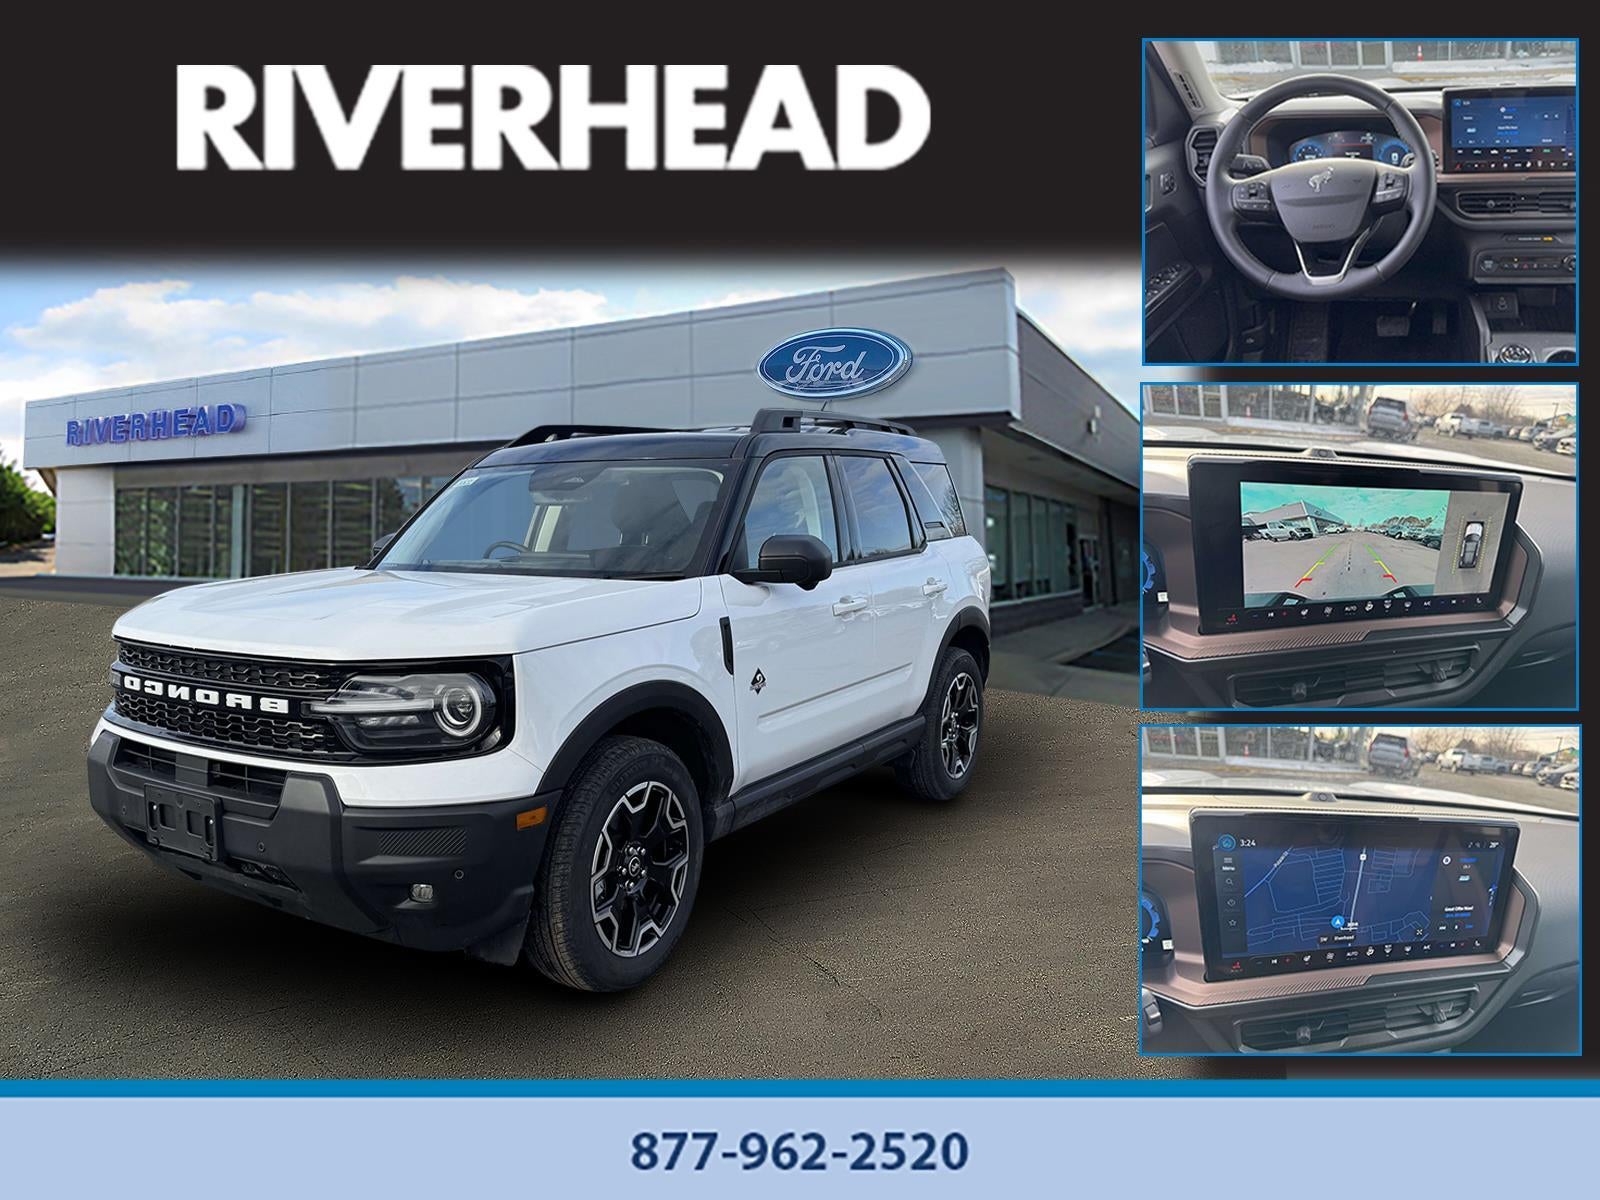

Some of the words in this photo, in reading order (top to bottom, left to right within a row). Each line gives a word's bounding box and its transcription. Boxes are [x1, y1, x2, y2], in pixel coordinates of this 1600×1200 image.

[785, 344, 867, 384] Ford
[66, 404, 248, 447] RIVERHEAD
[1240, 839, 1256, 847] 3:24
